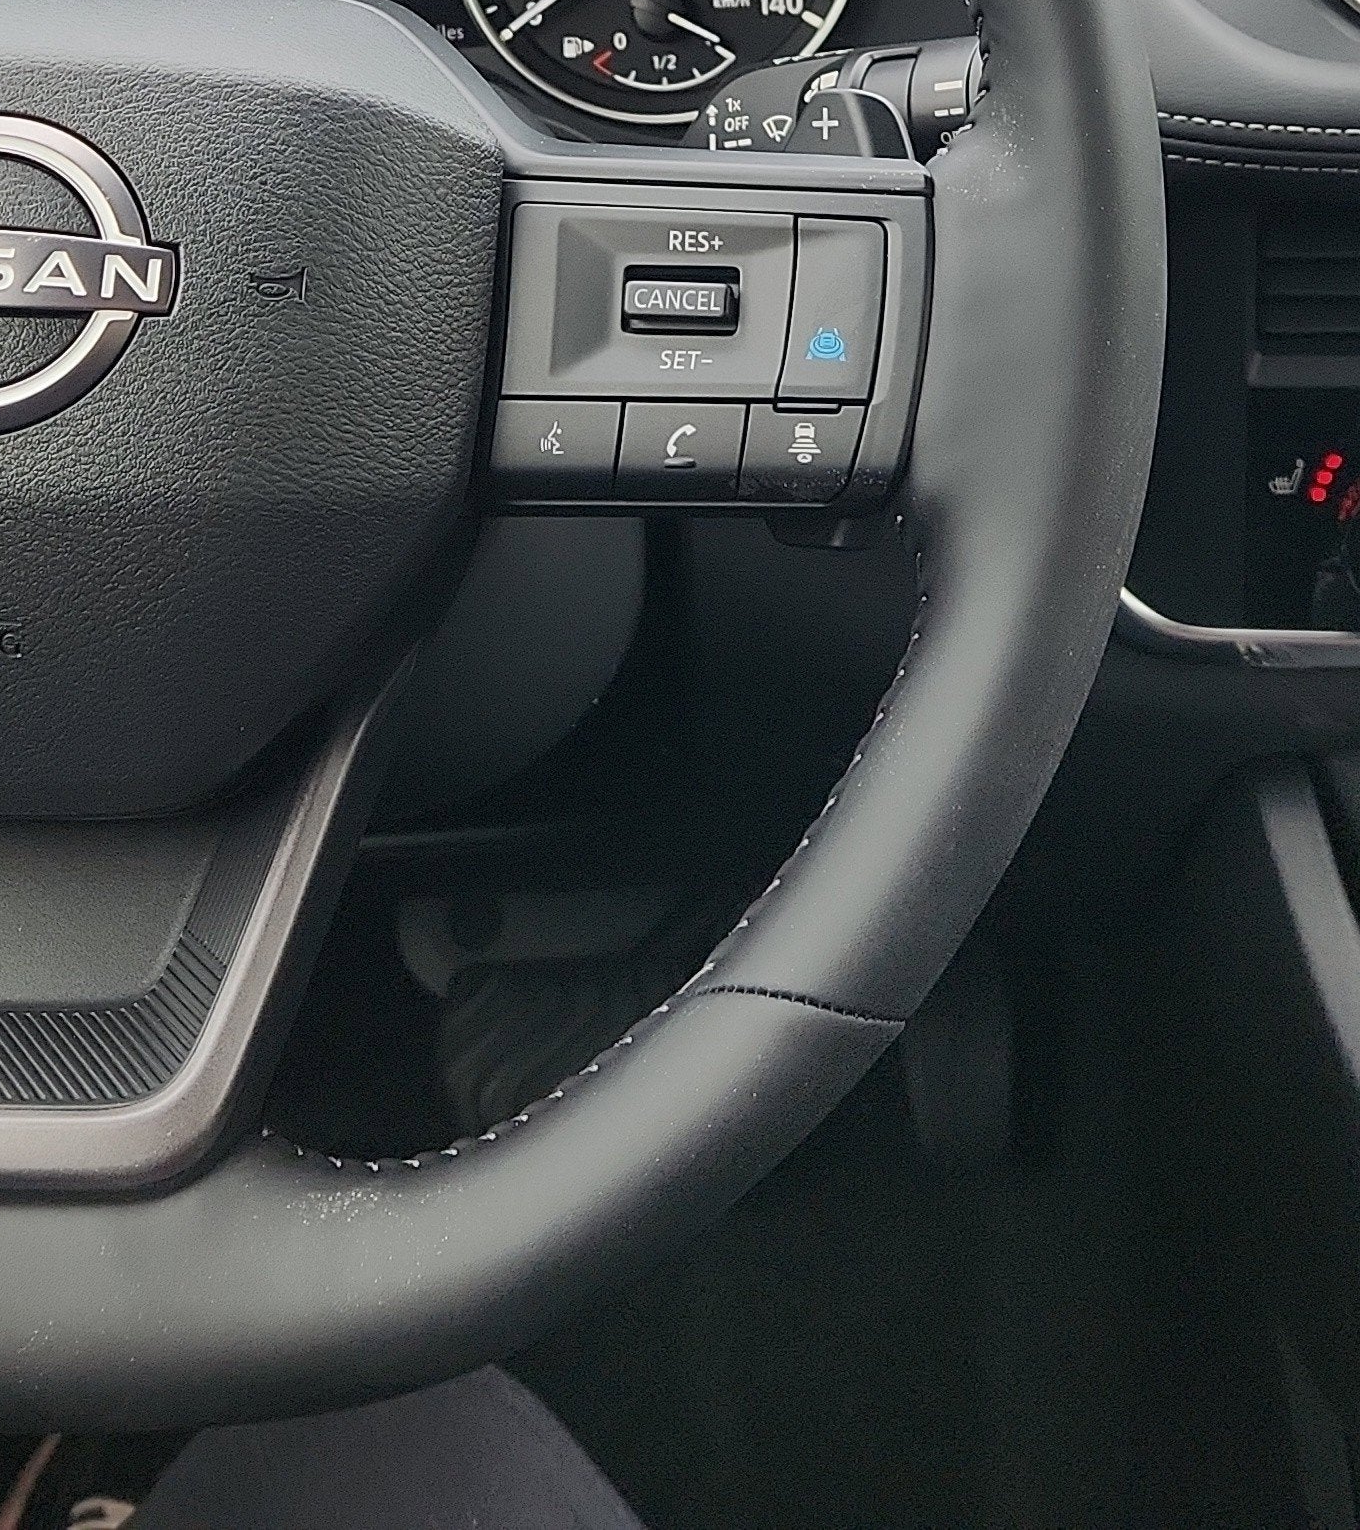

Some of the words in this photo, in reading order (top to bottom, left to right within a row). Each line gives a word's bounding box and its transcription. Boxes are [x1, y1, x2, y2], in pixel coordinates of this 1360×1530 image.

[612, 31, 628, 51] 0
[652, 54, 677, 71] 1/2
[724, 115, 750, 133] OFF
[668, 230, 724, 253] RES+
[633, 288, 721, 313] CANCEL
